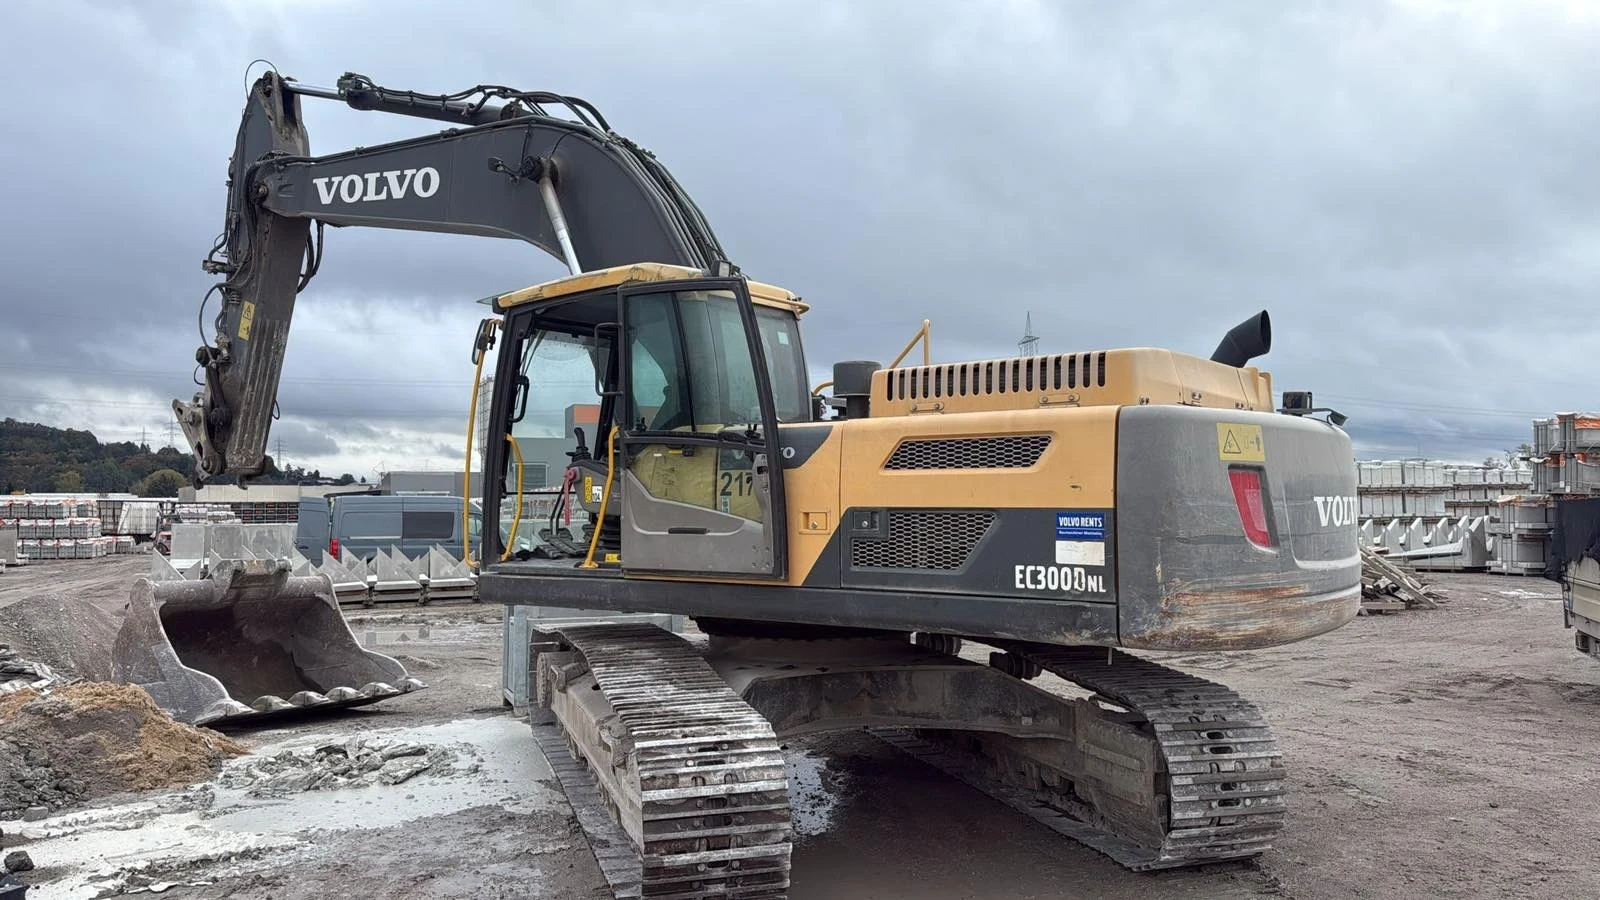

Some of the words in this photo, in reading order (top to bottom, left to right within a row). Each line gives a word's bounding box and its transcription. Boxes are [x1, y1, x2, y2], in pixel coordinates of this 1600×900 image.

[312, 166, 440, 205] VOLVO
[1058, 516, 1080, 527] VOLVO
[1080, 517, 1103, 528] RENTS
